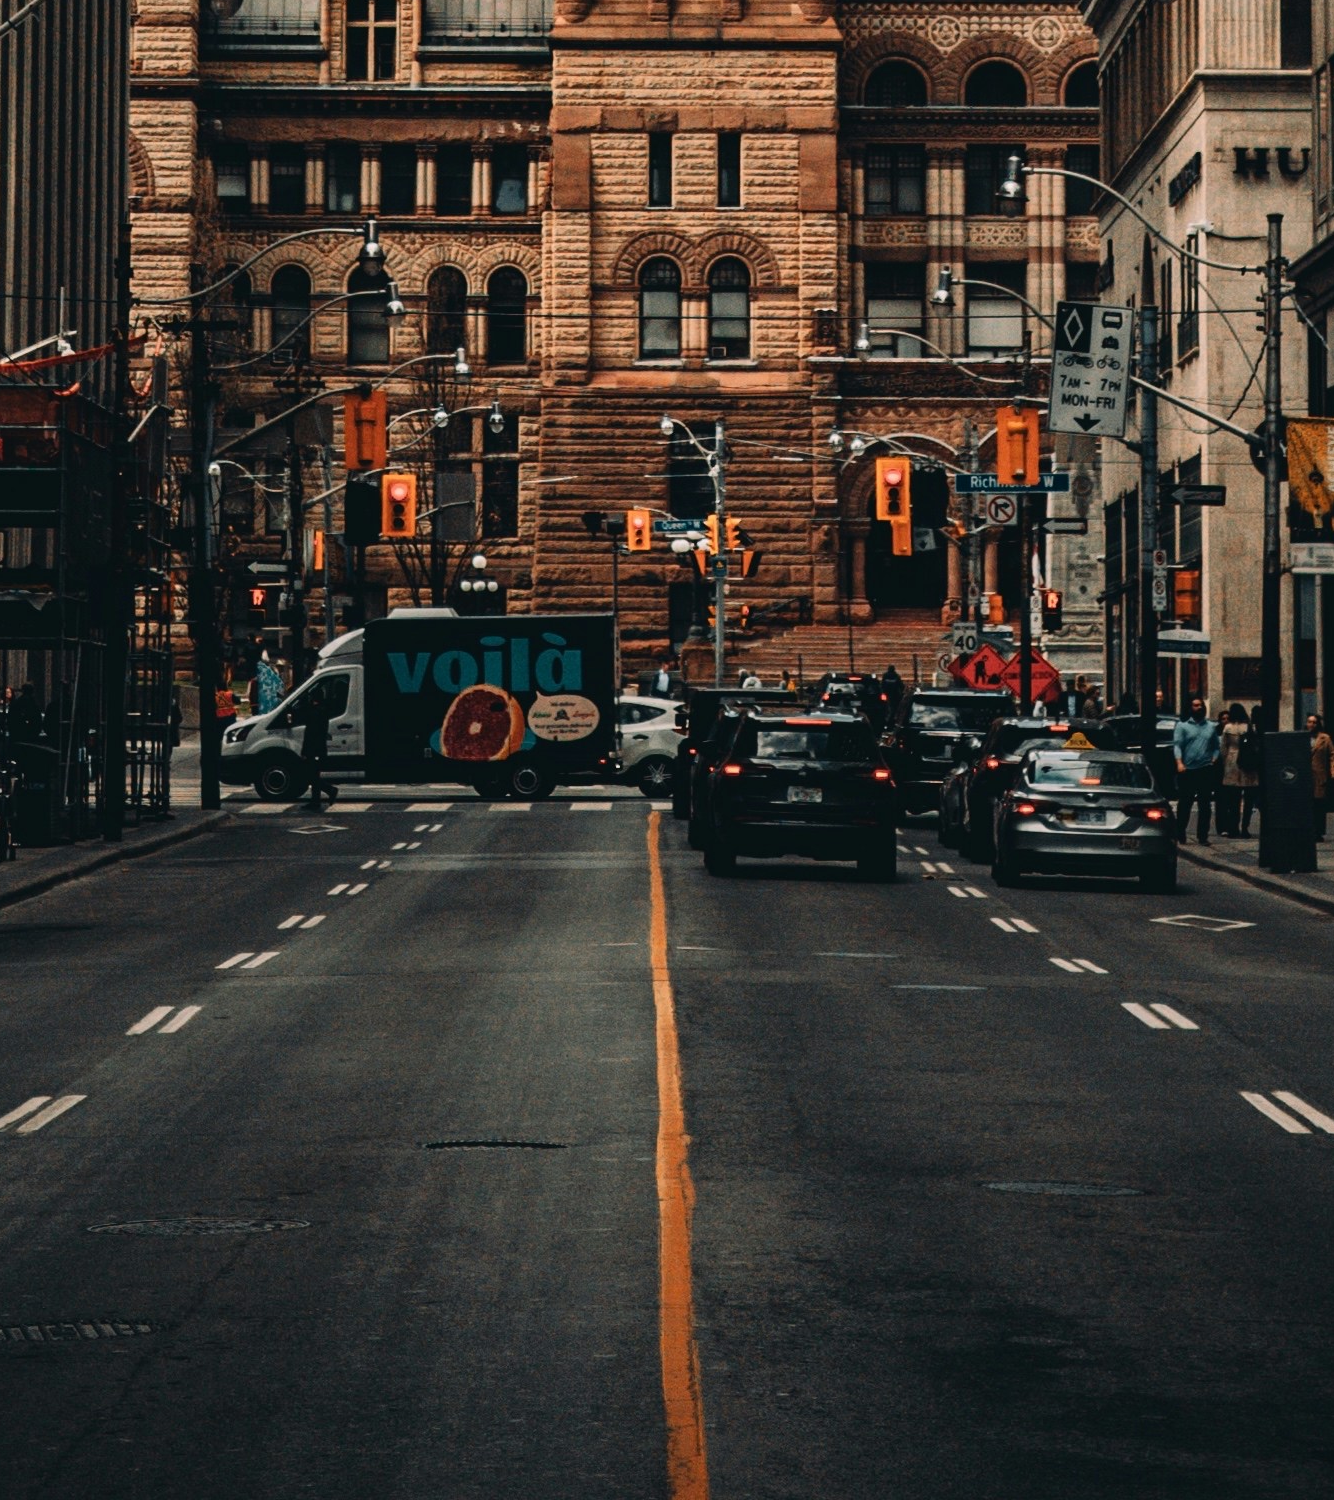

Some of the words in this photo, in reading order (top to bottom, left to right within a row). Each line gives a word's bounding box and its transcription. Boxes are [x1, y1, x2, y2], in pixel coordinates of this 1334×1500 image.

[1061, 394, 1116, 409] MON-FRI
[1043, 475, 1055, 488] W
[661, 520, 687, 530] Queen
[954, 635, 977, 651] 40
[386, 631, 583, 694] voilà
